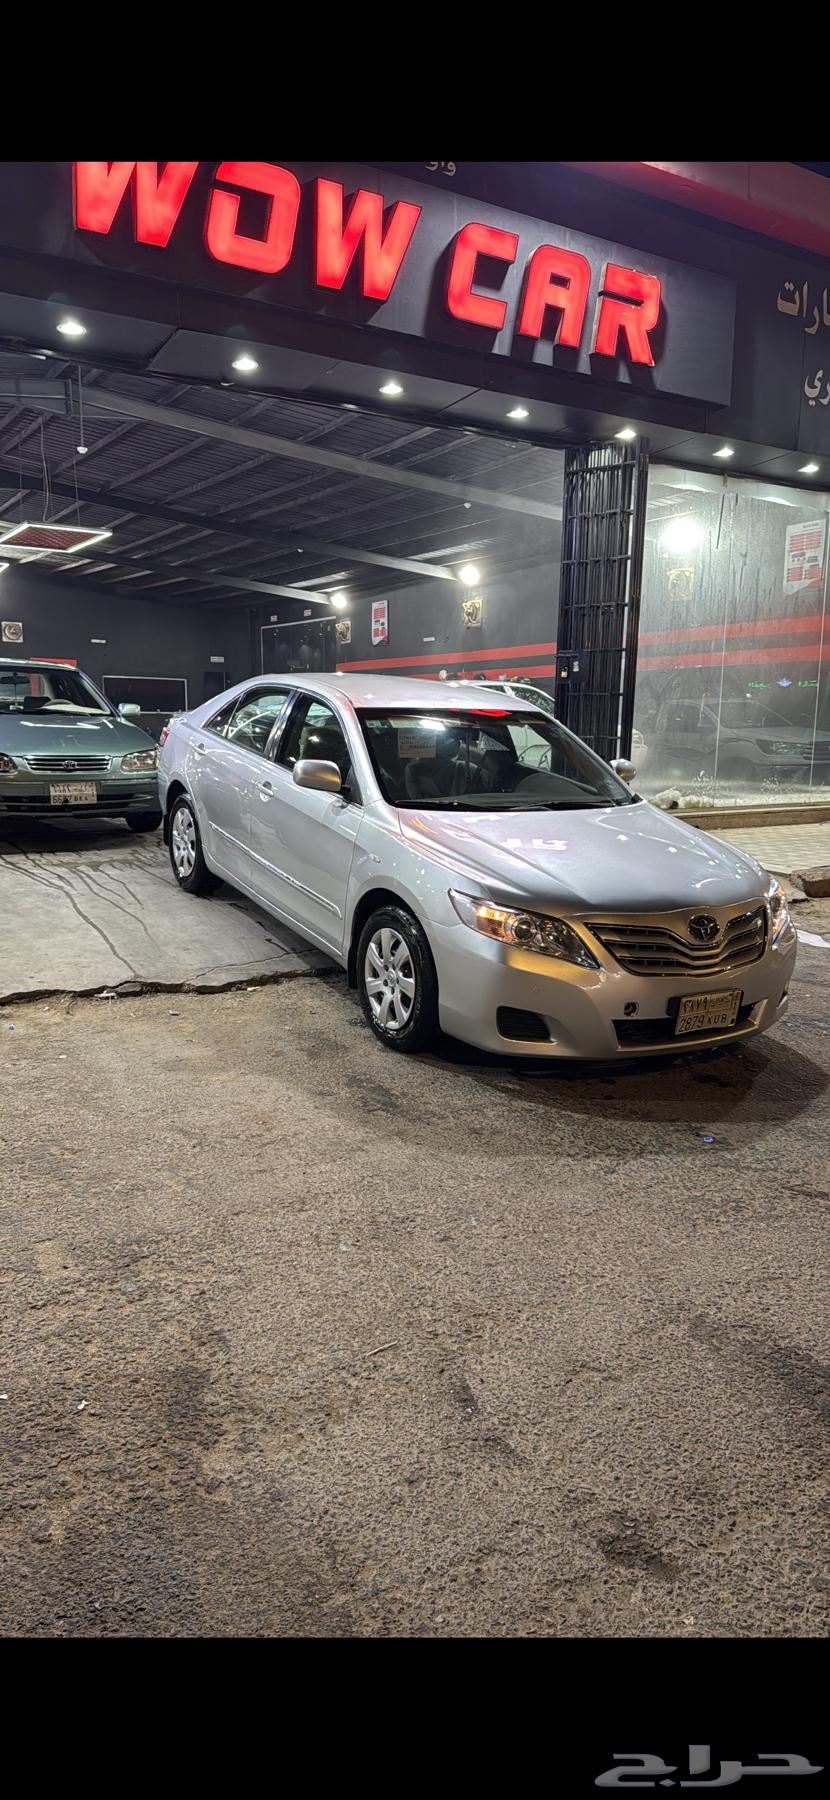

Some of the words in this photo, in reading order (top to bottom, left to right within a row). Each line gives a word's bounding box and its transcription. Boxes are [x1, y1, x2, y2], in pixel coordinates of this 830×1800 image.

[75, 161, 422, 301] WOW
[447, 222, 662, 367] CAR
[776, 280, 830, 335] ارات
[678, 1014, 705, 1033] 2879
